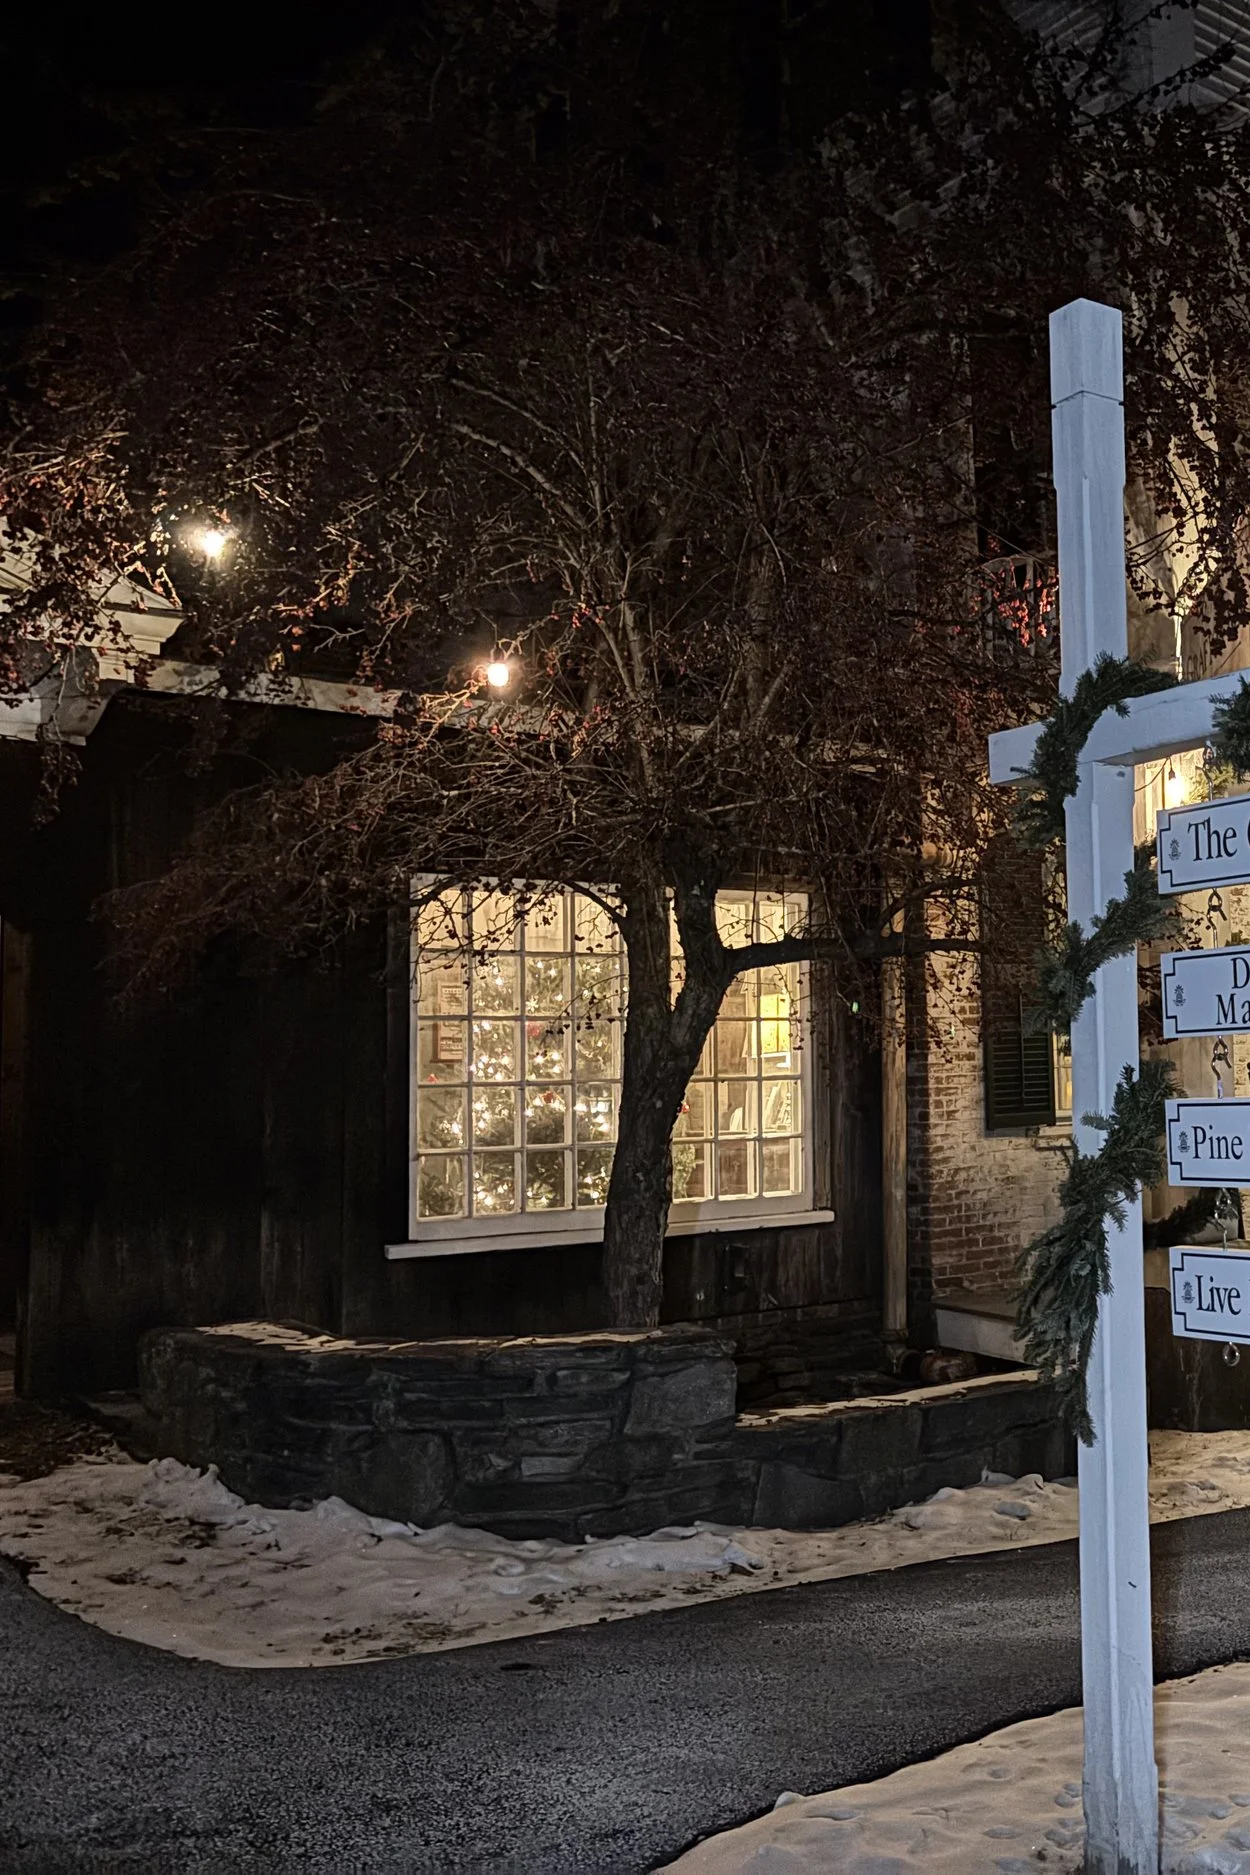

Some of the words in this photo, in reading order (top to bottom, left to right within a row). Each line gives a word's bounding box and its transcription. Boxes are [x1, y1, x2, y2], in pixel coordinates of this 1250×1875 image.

[1188, 817, 1238, 861] The
[1192, 1124, 1244, 1160] Pine
[1195, 1274, 1242, 1316] Live
